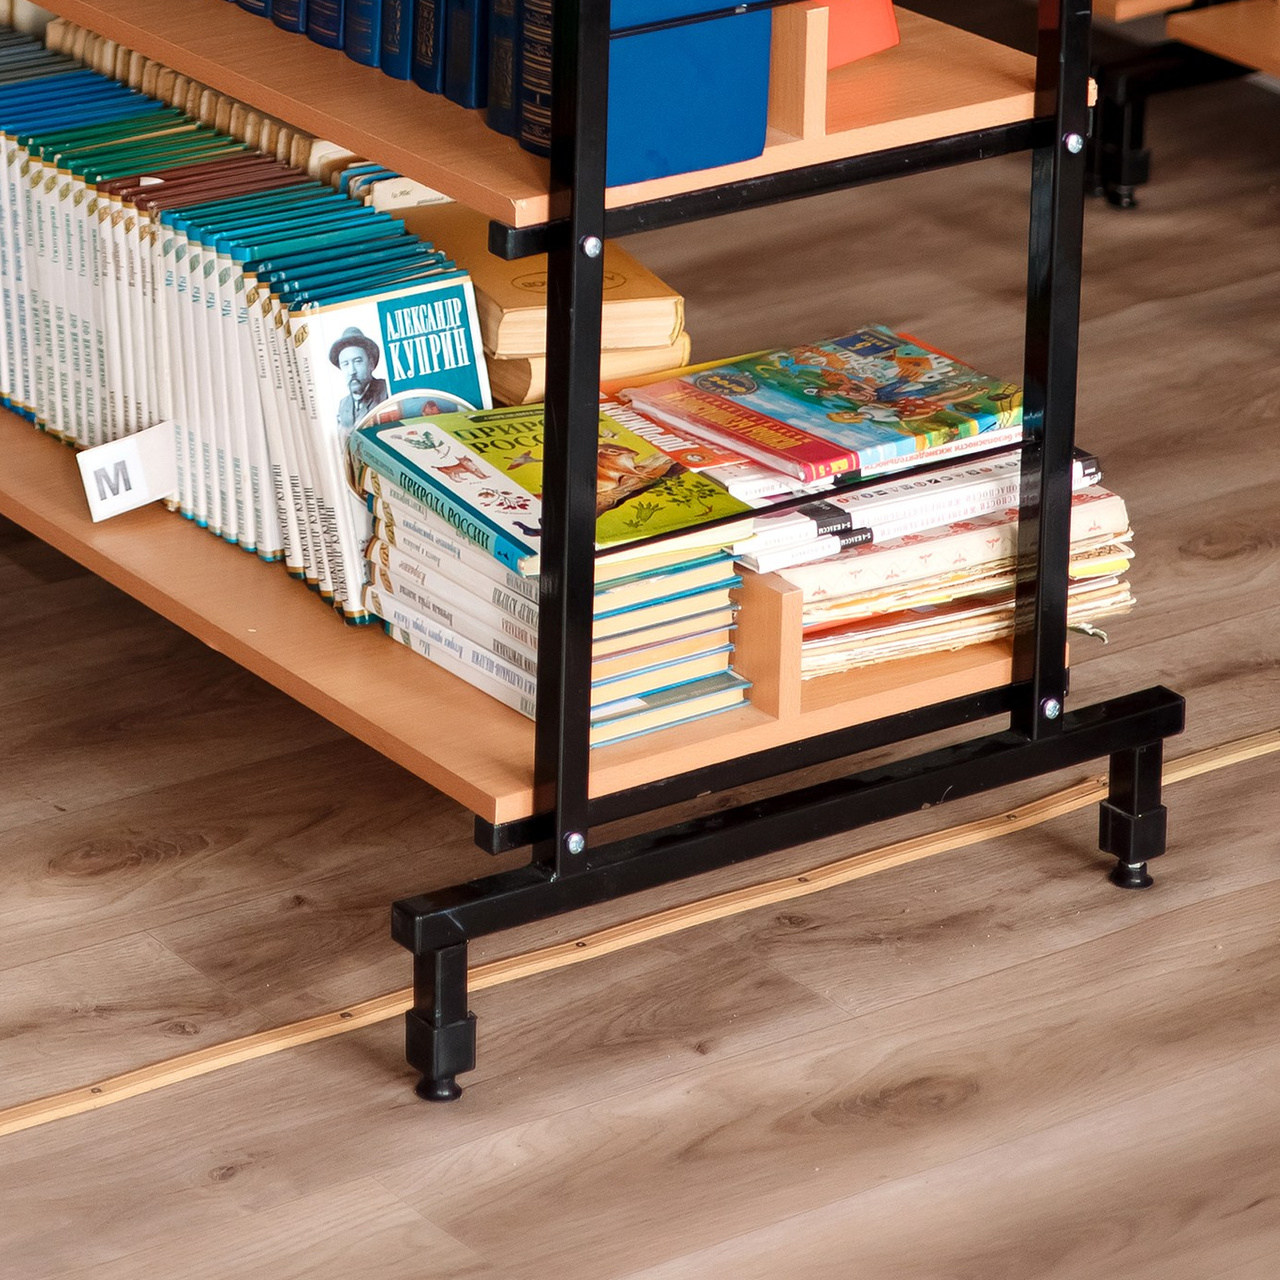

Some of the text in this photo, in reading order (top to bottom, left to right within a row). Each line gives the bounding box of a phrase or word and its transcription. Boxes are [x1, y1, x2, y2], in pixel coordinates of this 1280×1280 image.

[192, 286, 201, 303] Мы
[206, 292, 216, 310] Мы
[222, 300, 232, 318] Мы
[238, 306, 248, 325] Мы
[386, 298, 463, 340] АЛЕКСАНДР
[388, 328, 470, 381] КУПРИН
[954, 433, 1012, 452] безопасности
[93, 459, 132, 500] М
[272, 464, 284, 502] КУПРИН
[818, 465, 825, 478] 5
[290, 475, 312, 571] АЛЕКСАНДР КУПРИН
[400, 472, 490, 548] ПРИРОДА РОССИИ
[304, 487, 326, 584] АЛЕКСАНДР КУПРИН
[325, 506, 349, 604] АЛЕКСАНДР КУПРИН
[398, 560, 426, 585] Избранное
[492, 587, 517, 614] КУПРИН
[419, 639, 430, 657] Мы
